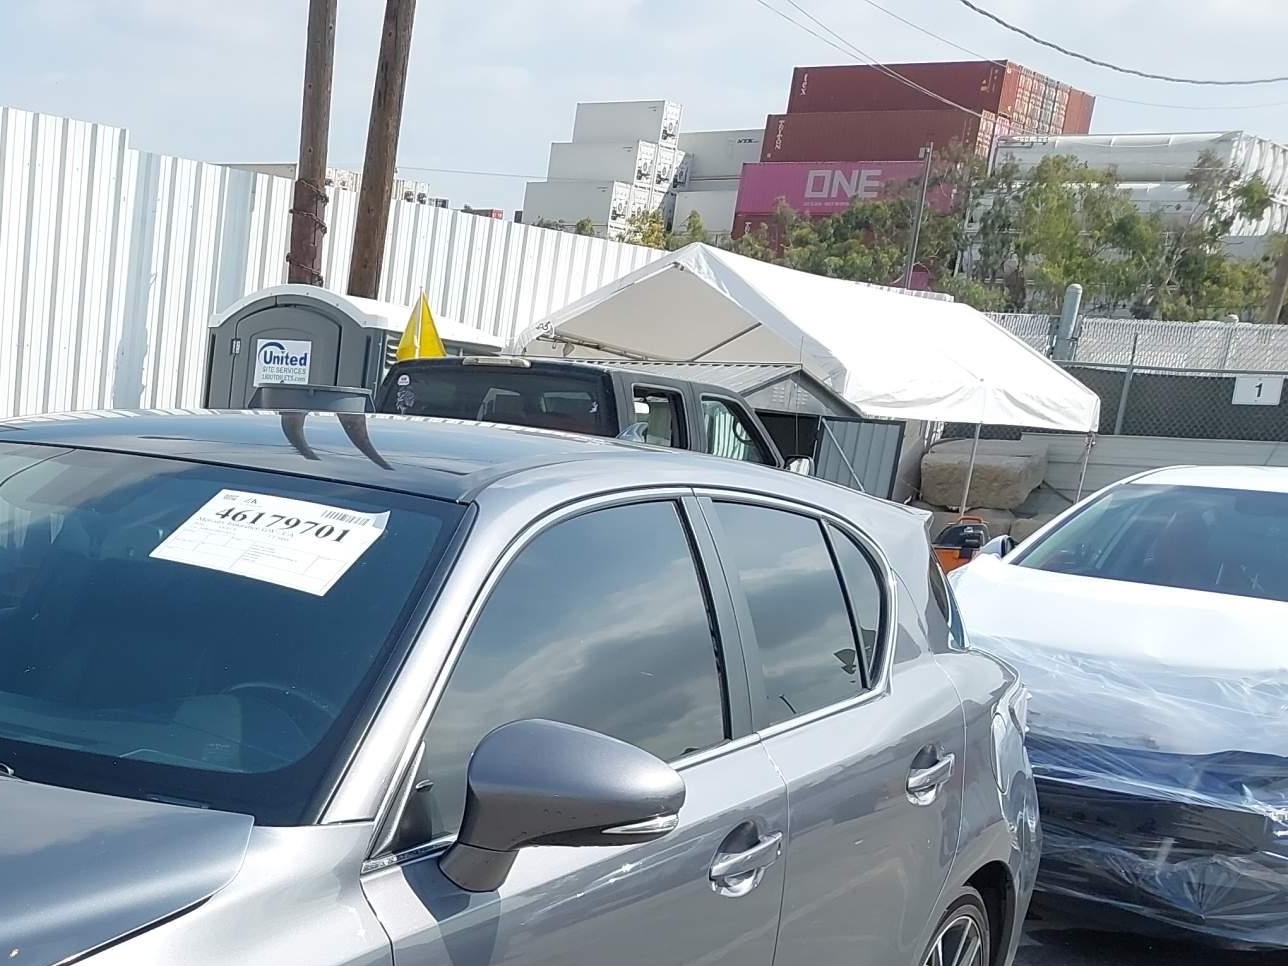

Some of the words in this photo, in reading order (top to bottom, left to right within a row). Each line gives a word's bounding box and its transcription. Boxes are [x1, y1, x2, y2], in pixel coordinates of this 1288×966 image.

[804, 169, 882, 198] ONE
[263, 350, 308, 366] United
[275, 366, 307, 375] SERVICES
[1255, 382, 1264, 398] 1
[215, 506, 352, 543] 46179701
